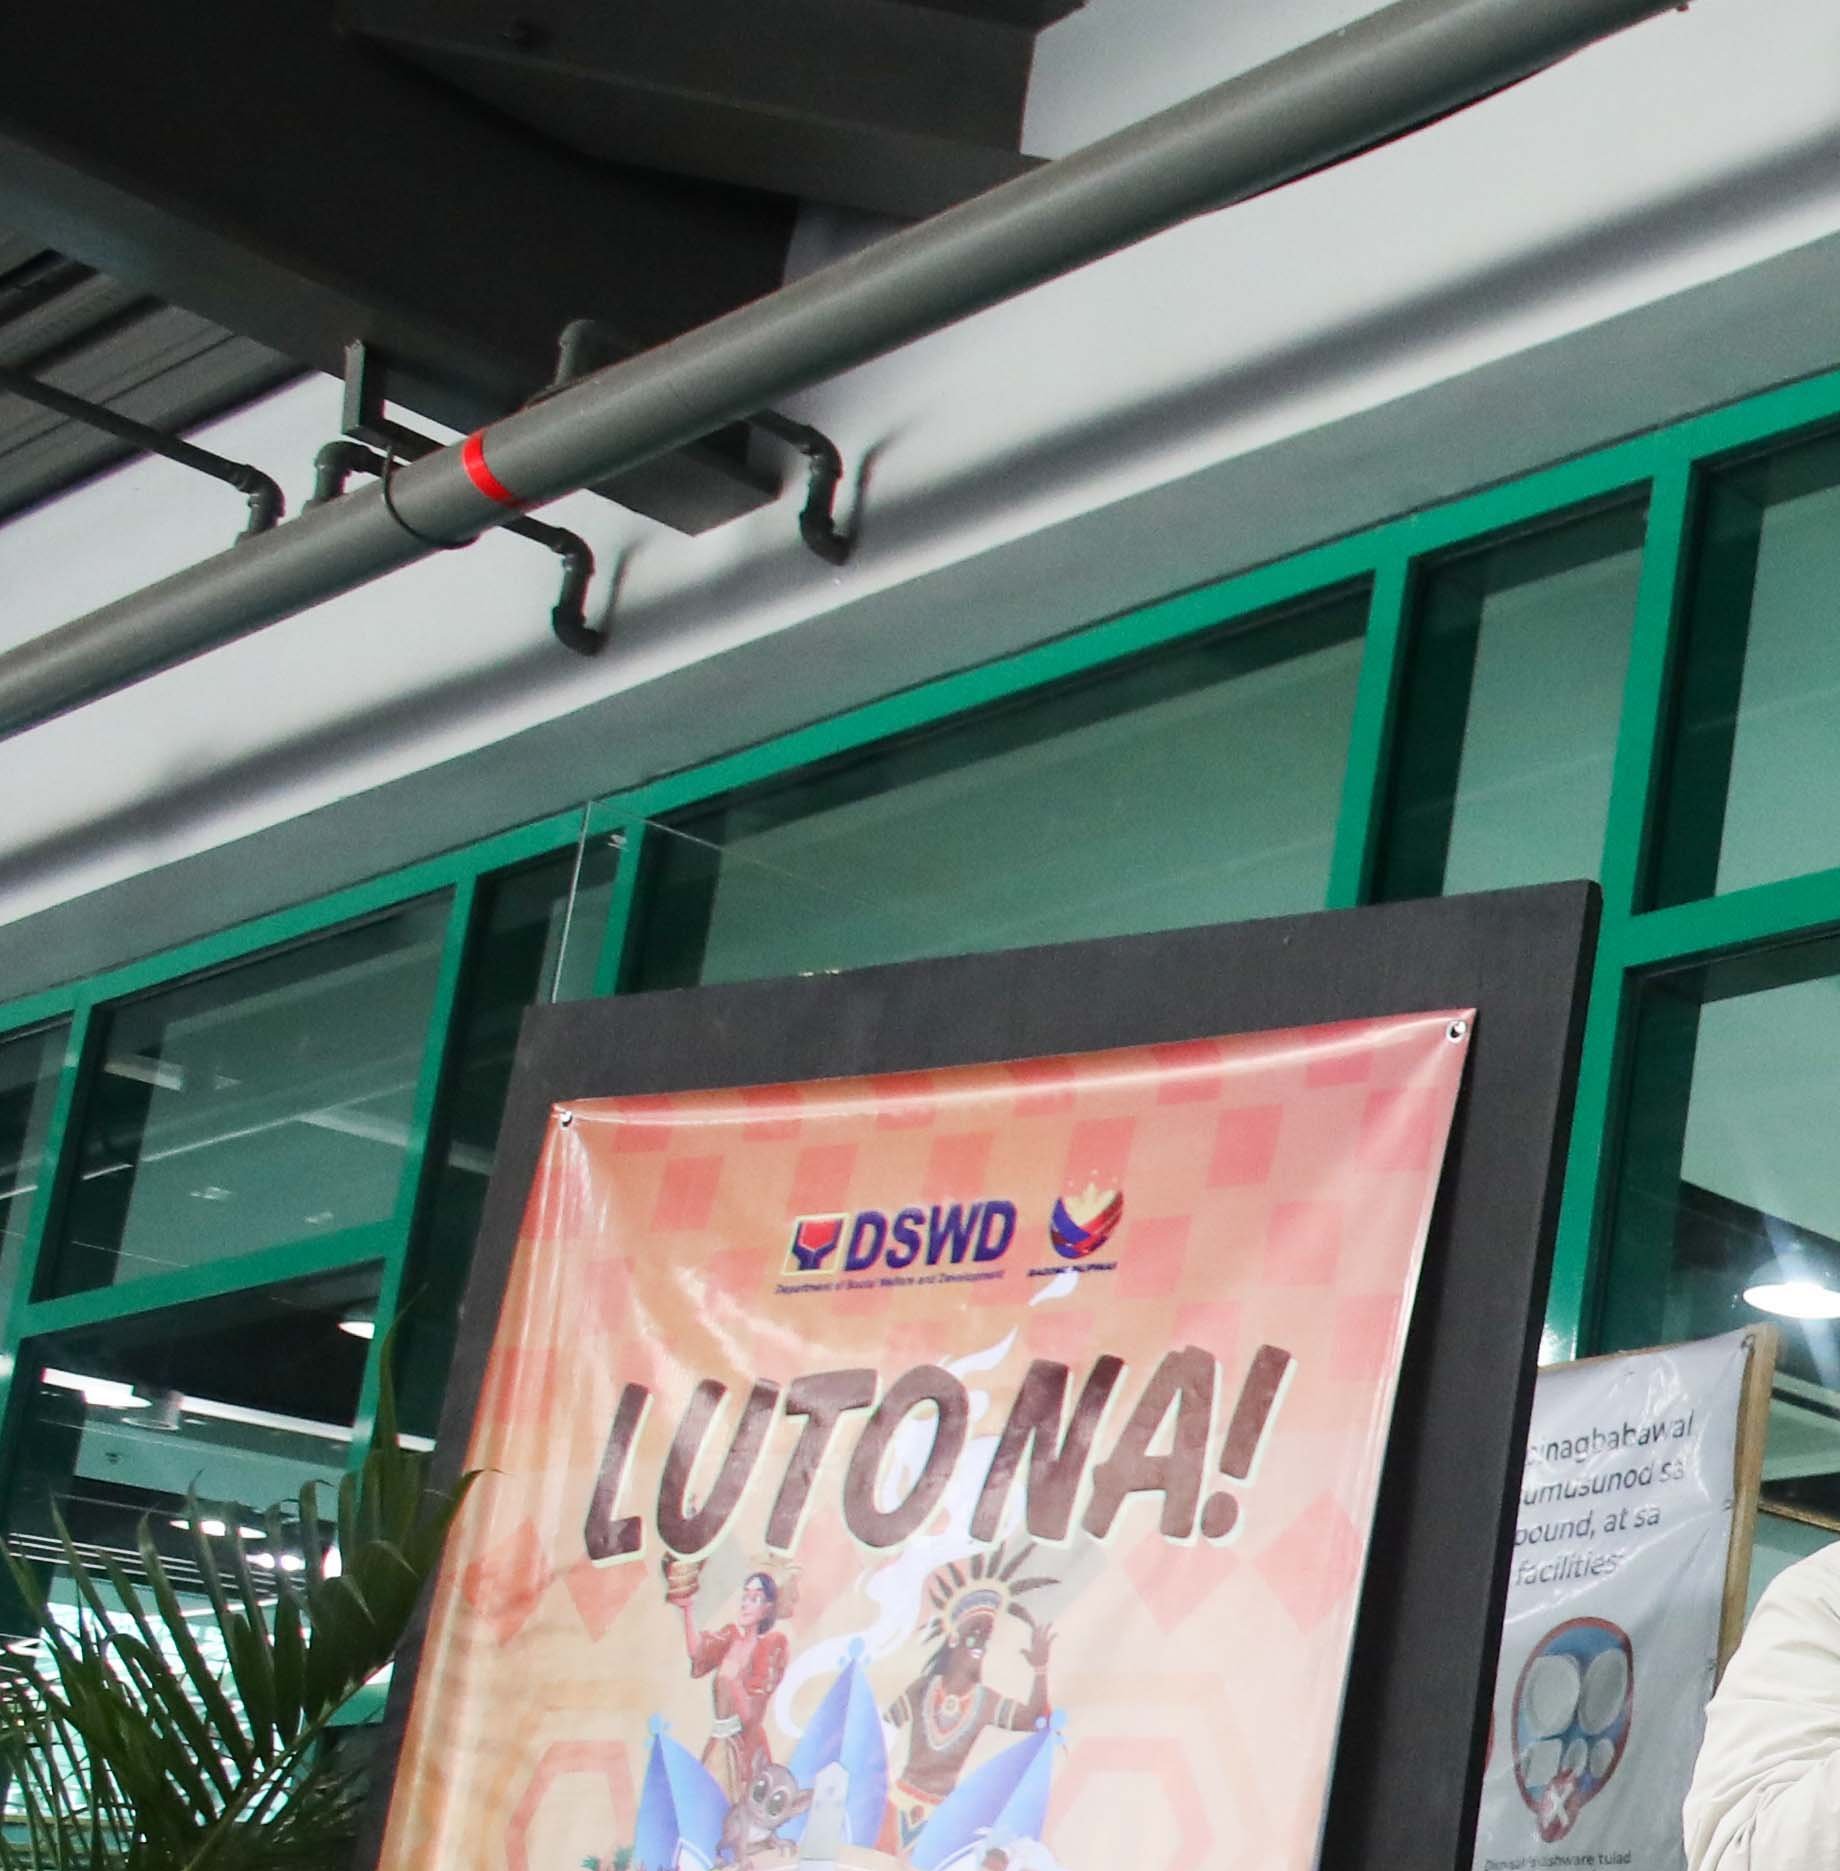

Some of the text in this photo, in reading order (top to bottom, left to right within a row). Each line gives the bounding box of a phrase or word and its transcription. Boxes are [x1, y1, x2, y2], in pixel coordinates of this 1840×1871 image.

[844, 1199, 1017, 1272] DSWD
[584, 1343, 1297, 1566] LUTO NA!
[1522, 1461, 1654, 1506] umusunod
[1604, 1509, 1628, 1533] at
[1633, 1505, 1662, 1527] sa
